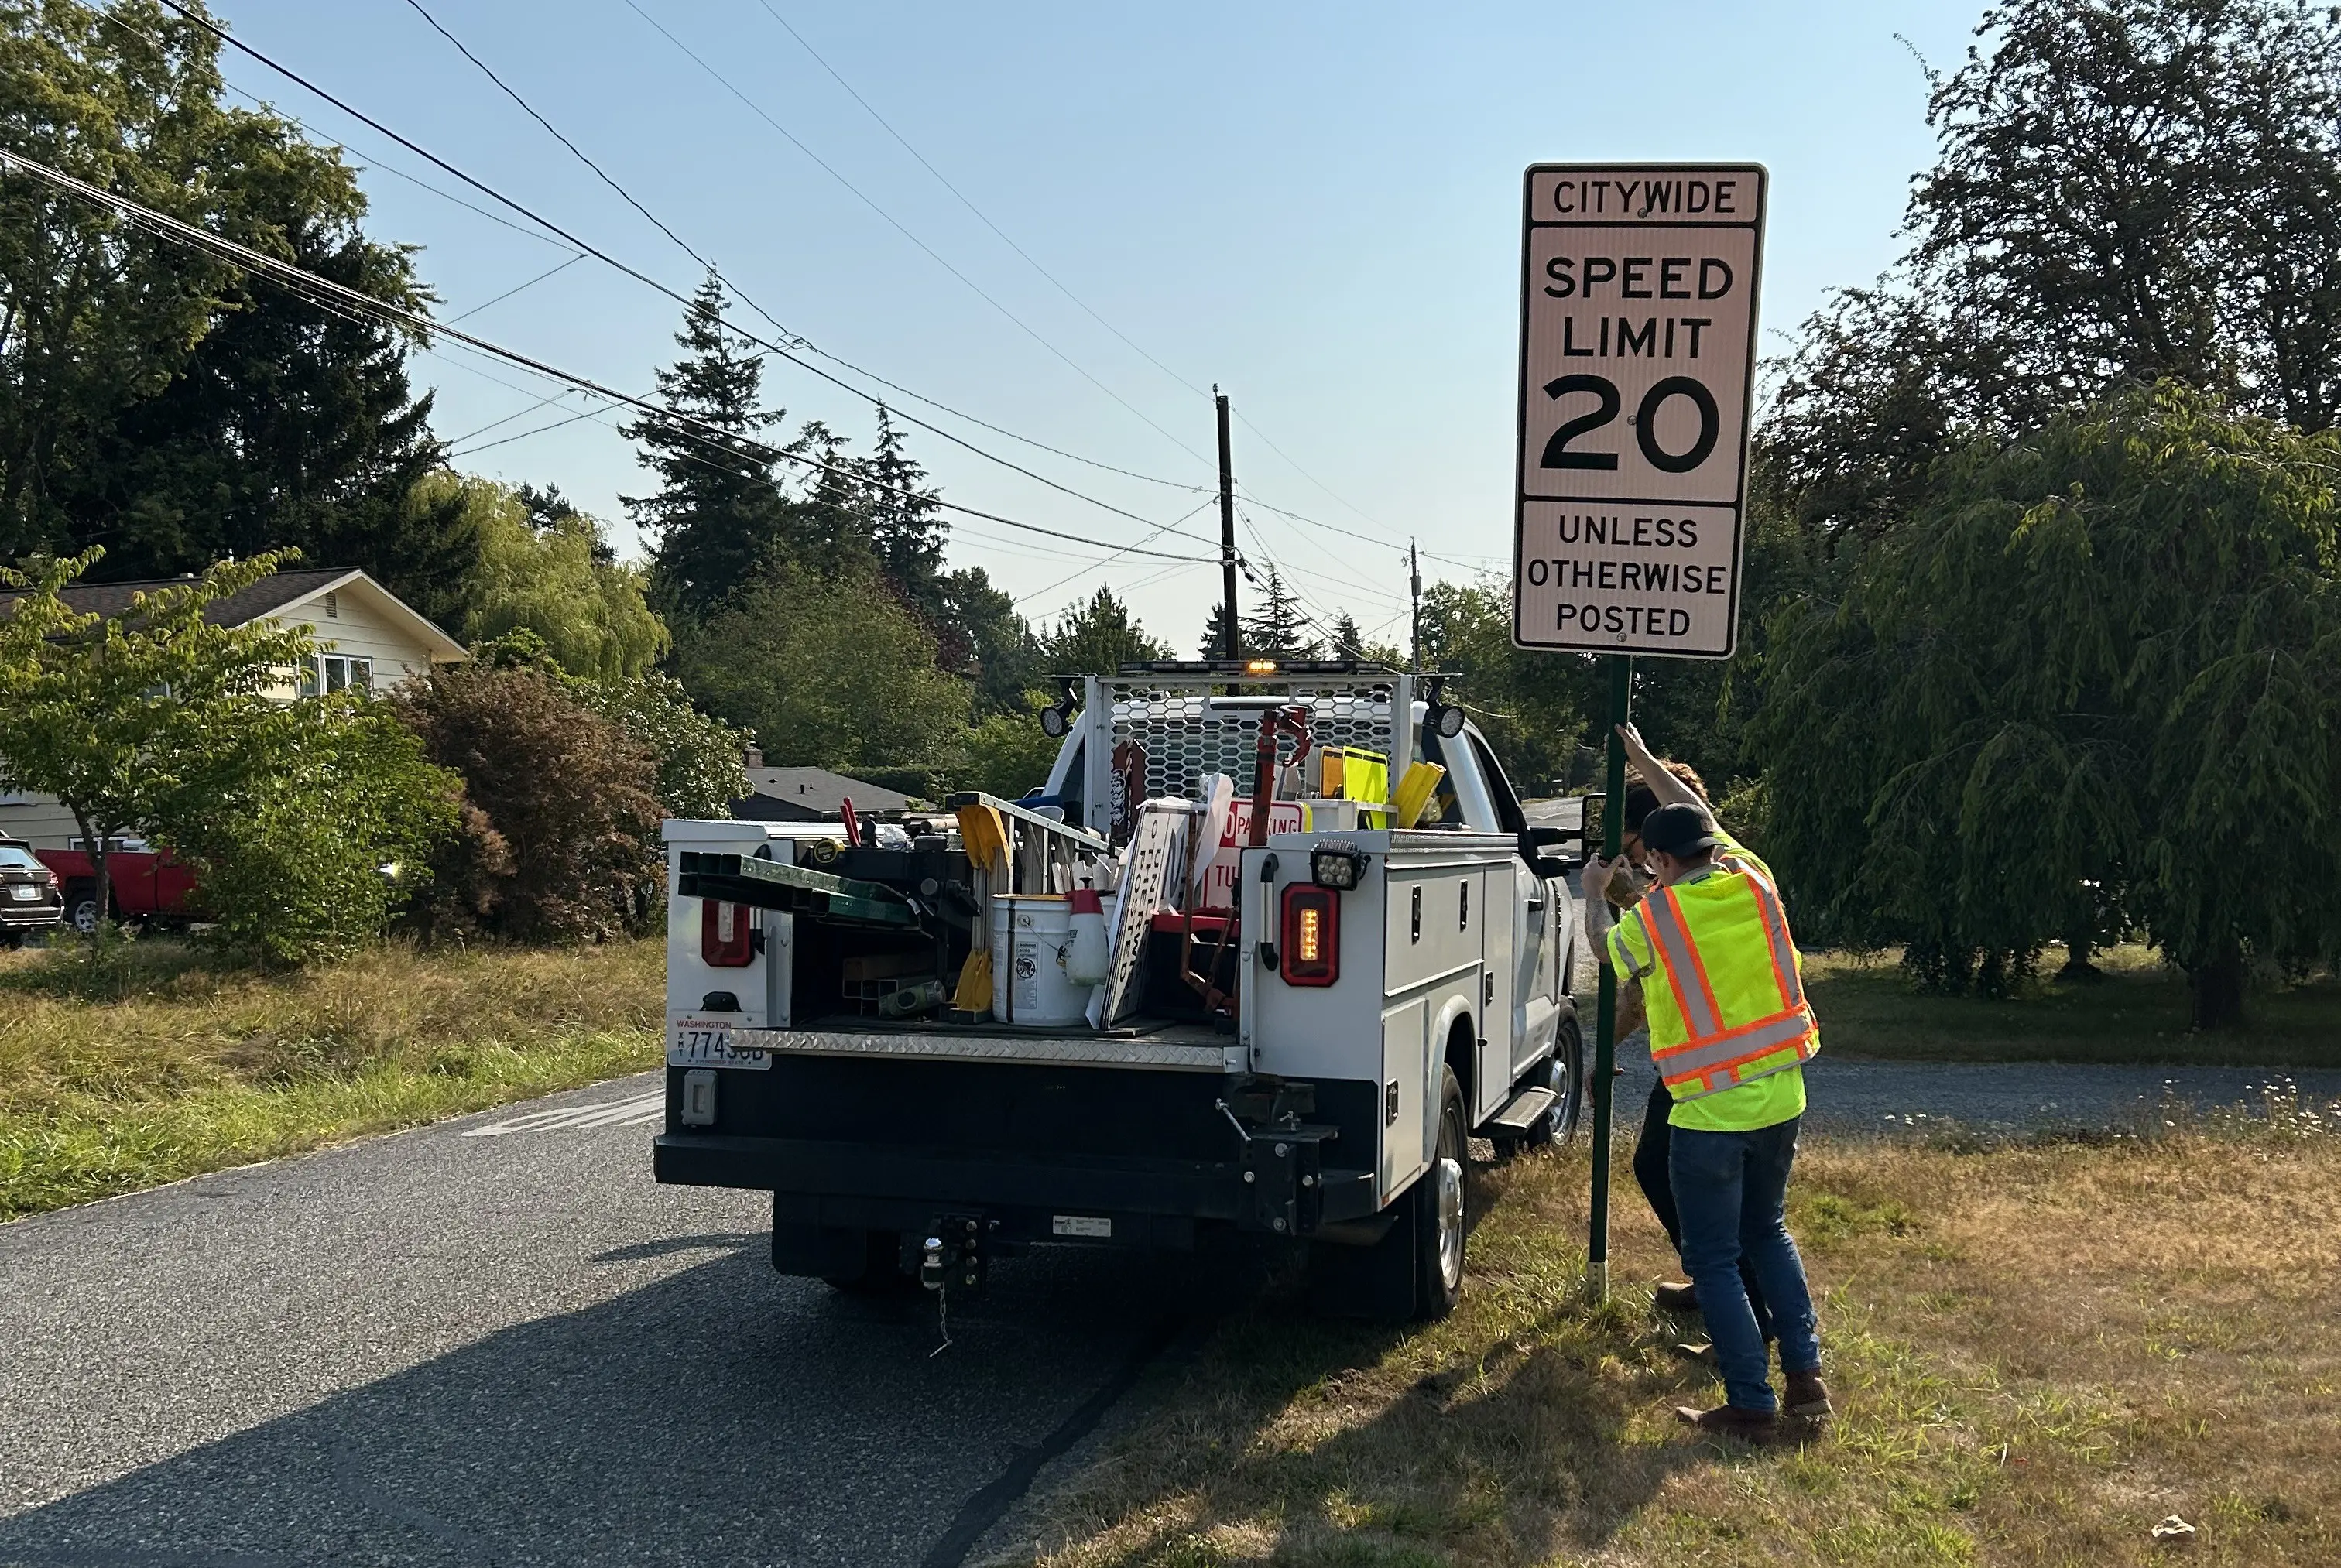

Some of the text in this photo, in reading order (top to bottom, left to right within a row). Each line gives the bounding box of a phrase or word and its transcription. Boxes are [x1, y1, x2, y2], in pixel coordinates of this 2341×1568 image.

[1554, 180, 1736, 214] CITYWIDE
[1543, 257, 1733, 300] SPEED
[1563, 317, 1712, 358] LIMIT
[1540, 374, 1720, 474] 20
[1559, 515, 1698, 548] UNLESS
[1527, 559, 1726, 594] OTHERWISE
[1557, 604, 1691, 636] POSTED
[1238, 817, 1297, 835] PAING
[677, 1020, 732, 1029] WASHINGTON
